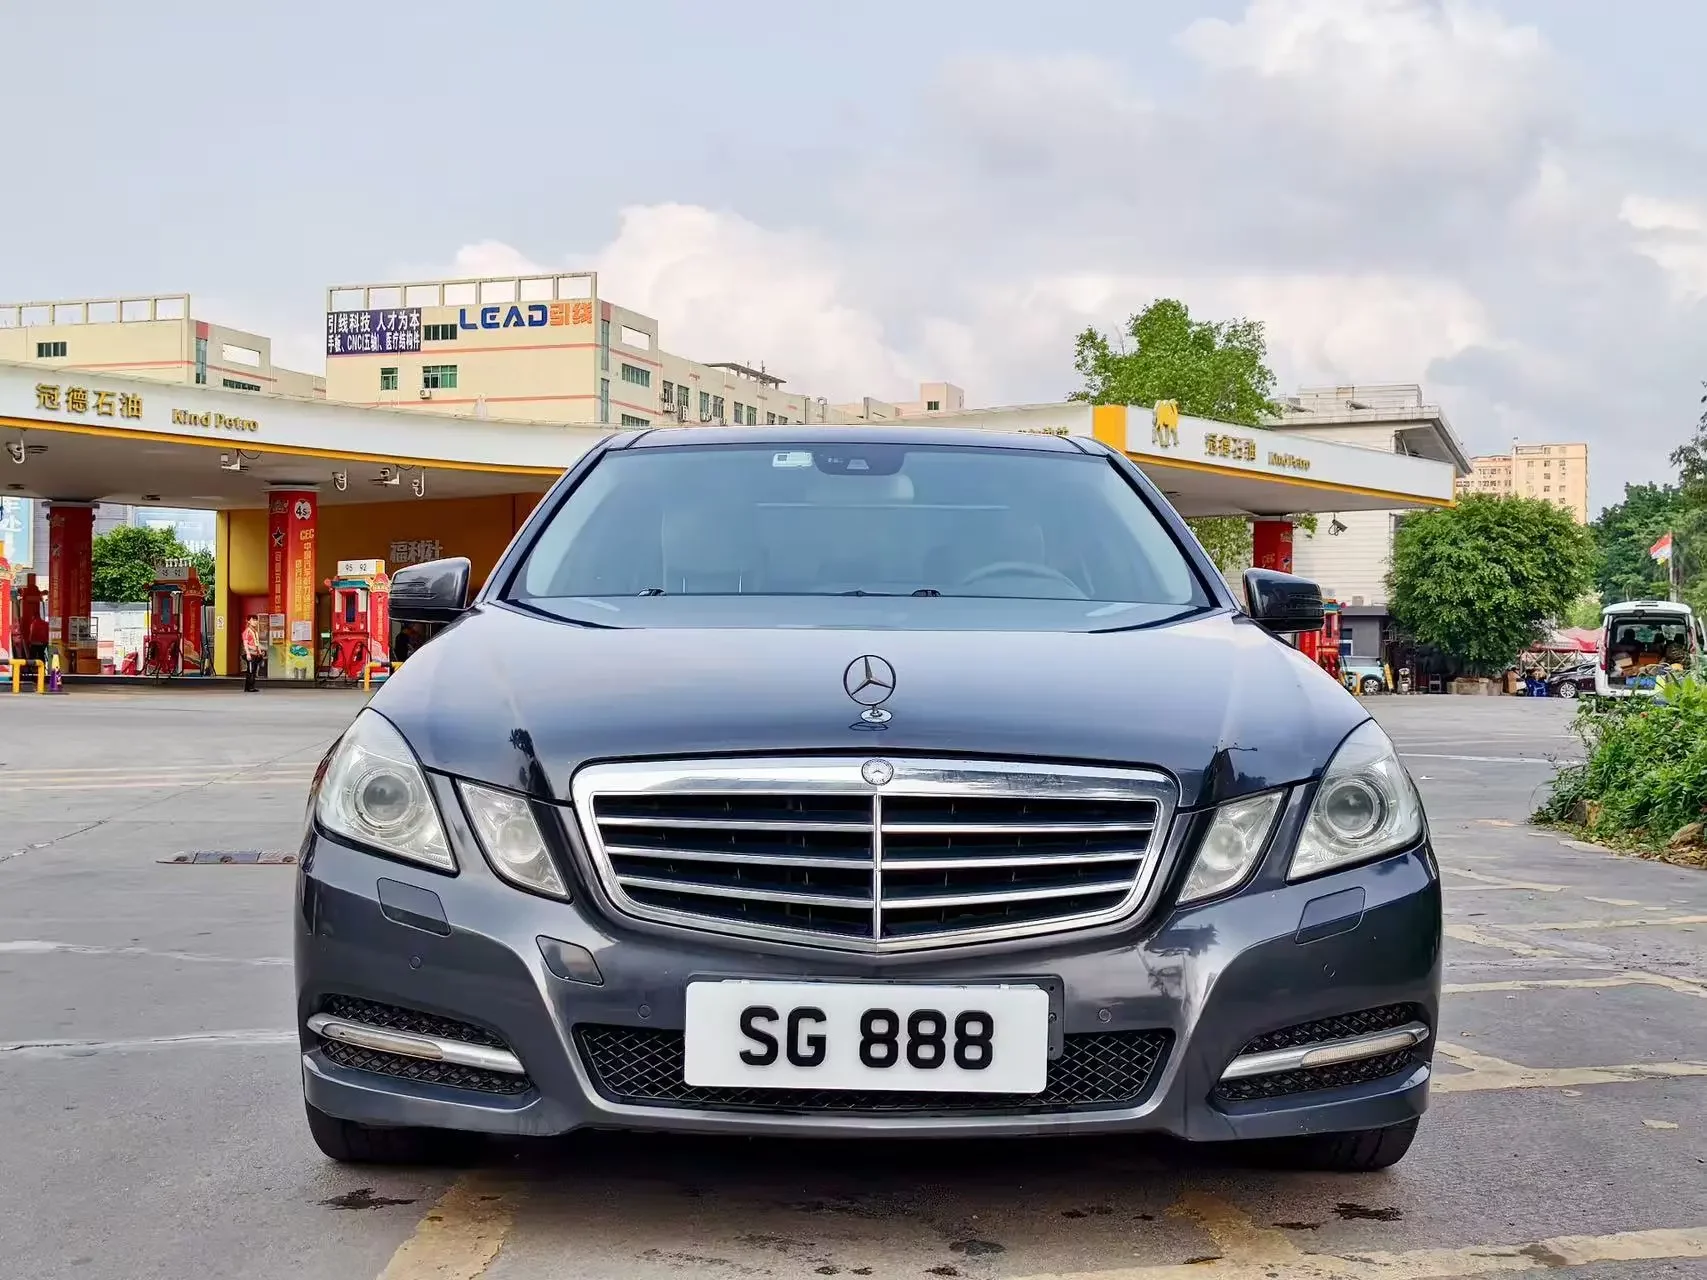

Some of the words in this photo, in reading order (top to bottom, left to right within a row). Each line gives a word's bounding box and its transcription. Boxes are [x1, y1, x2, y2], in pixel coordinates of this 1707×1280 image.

[328, 312, 371, 334] 引线科技
[376, 309, 420, 331] 人才为本
[459, 304, 548, 330] LEAD
[35, 382, 143, 419] 冠德石油
[171, 408, 211, 427] Kind
[215, 413, 259, 432] Petro
[739, 1005, 827, 1067] SG
[859, 1007, 994, 1070] 888
